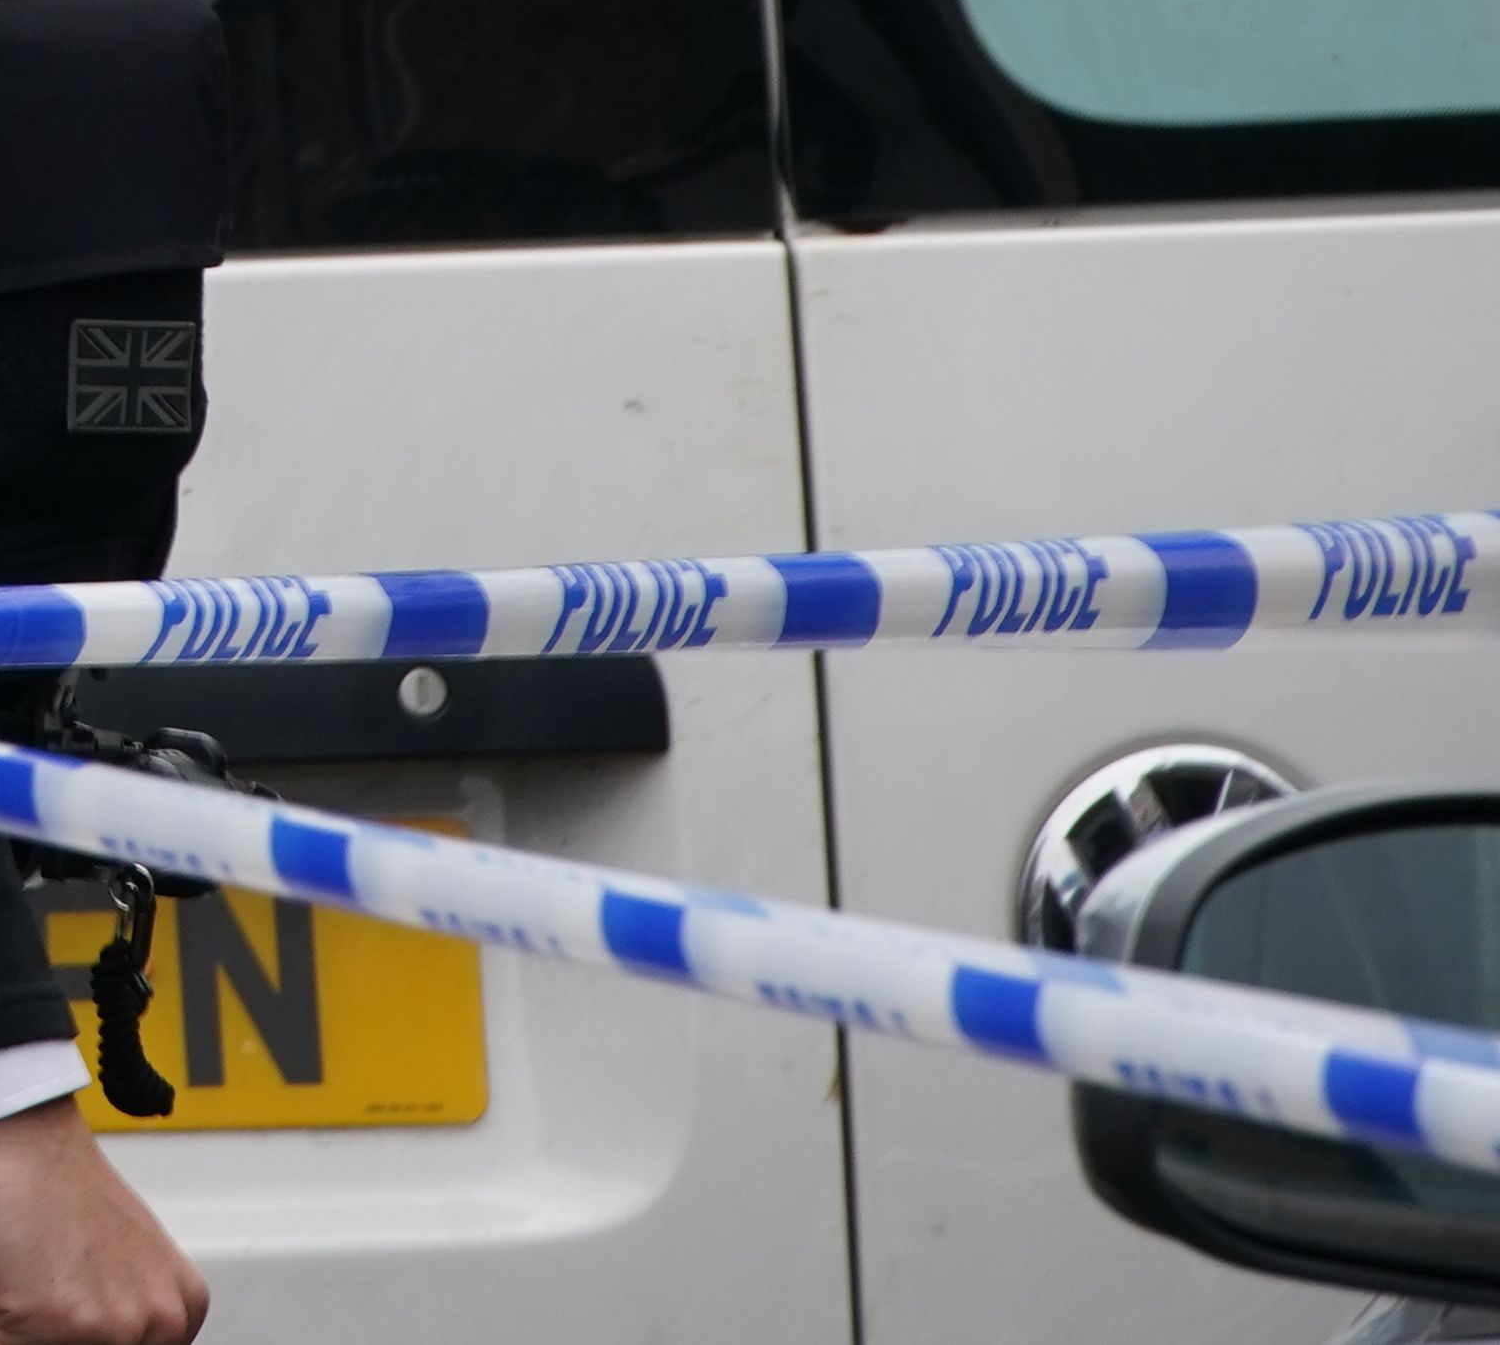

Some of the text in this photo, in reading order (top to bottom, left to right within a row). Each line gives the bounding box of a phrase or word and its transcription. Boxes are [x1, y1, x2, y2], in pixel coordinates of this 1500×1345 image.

[138, 575, 333, 665] POLICE
[540, 557, 728, 654] POLICE
[927, 539, 1109, 637] POLICE
[1295, 515, 1477, 622] POLICE
